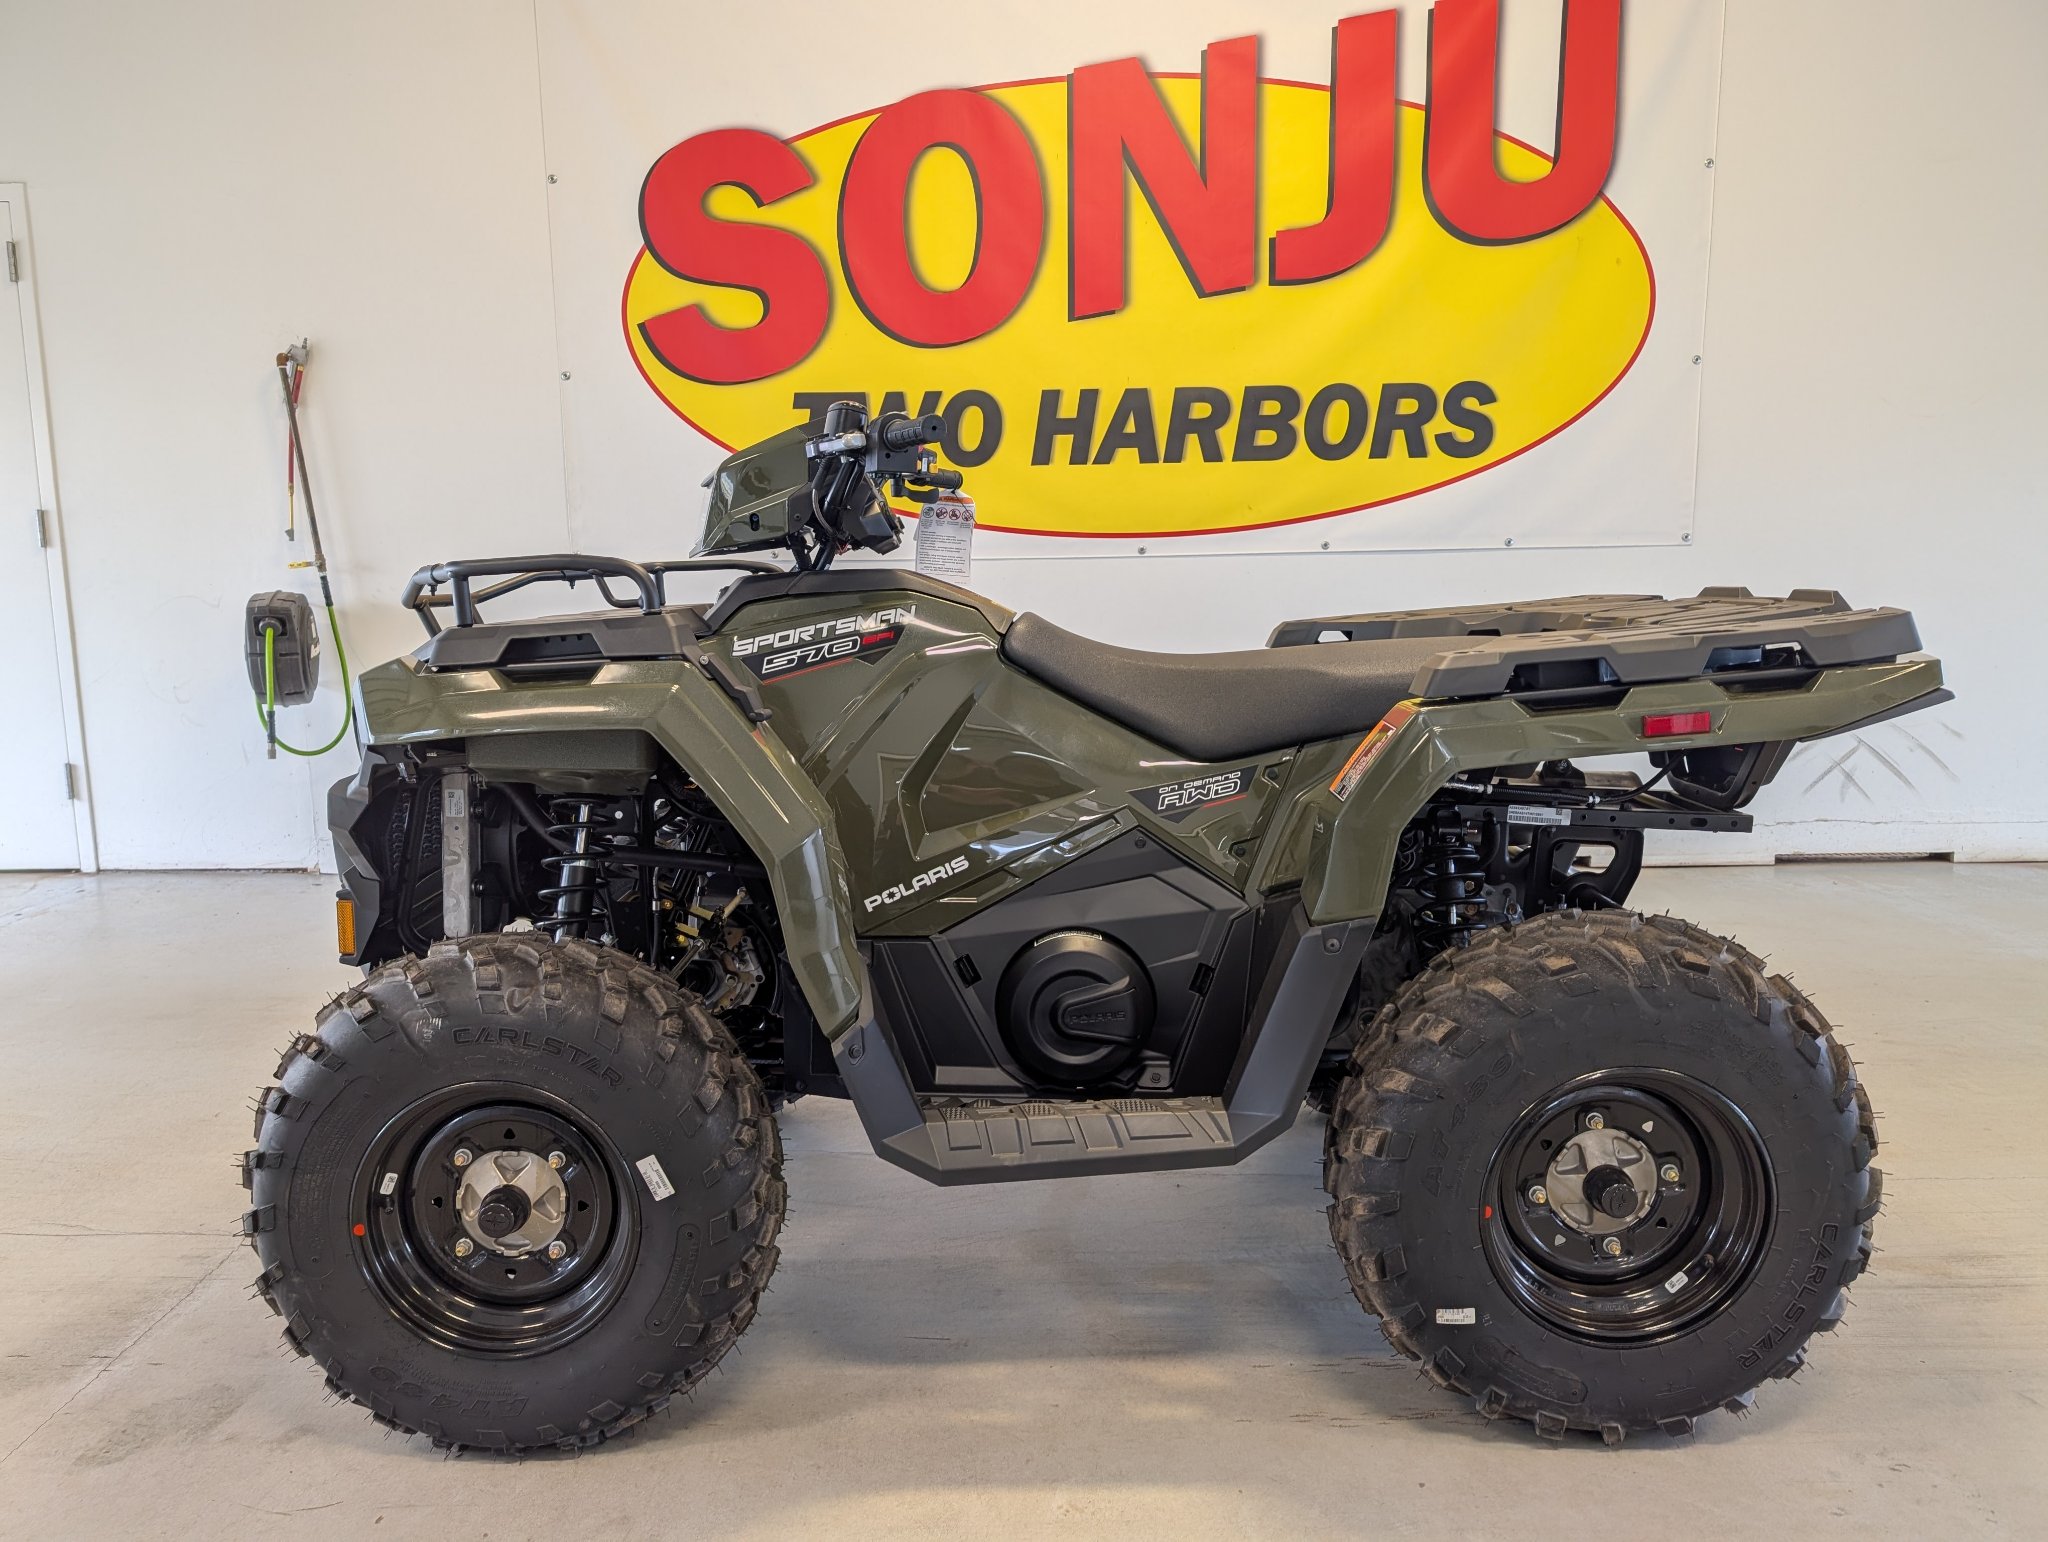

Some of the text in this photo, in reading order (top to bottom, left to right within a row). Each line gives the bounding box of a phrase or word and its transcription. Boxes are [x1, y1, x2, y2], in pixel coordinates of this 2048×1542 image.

[638, 0, 1622, 384] SONJU
[1031, 380, 1498, 467] HARBORS
[732, 604, 918, 657] SPORTSMAN
[762, 635, 861, 674] 570
[1157, 778, 1241, 811] AWD
[1158, 771, 1241, 794] ON DEMAND
[863, 855, 970, 912] POLARIS
[1069, 1010, 1127, 1025] POLARIS
[450, 1025, 625, 1088] CARLSTAR
[1736, 1222, 1840, 1369] CARLSTAR
